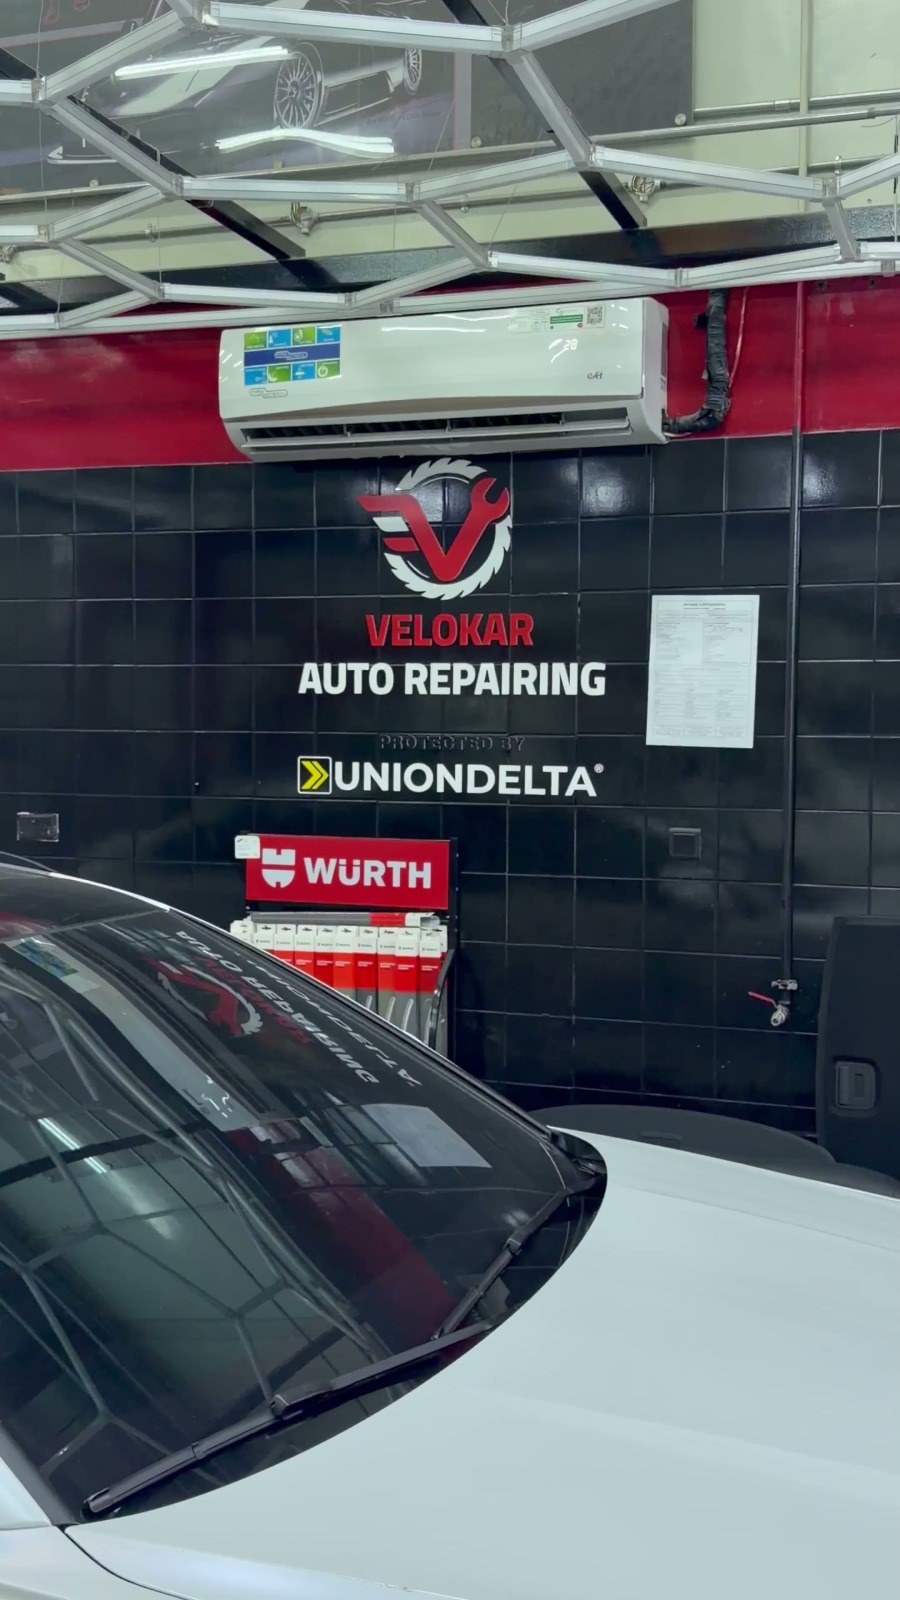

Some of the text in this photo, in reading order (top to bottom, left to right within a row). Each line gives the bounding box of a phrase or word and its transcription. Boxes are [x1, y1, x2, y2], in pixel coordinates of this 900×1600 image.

[563, 338, 578, 351] 28
[366, 613, 534, 647] VELOKAR
[298, 662, 606, 696] AUTO REPAIRING
[380, 735, 526, 751] PROTECTED BY
[303, 857, 432, 889] WÜRTH
